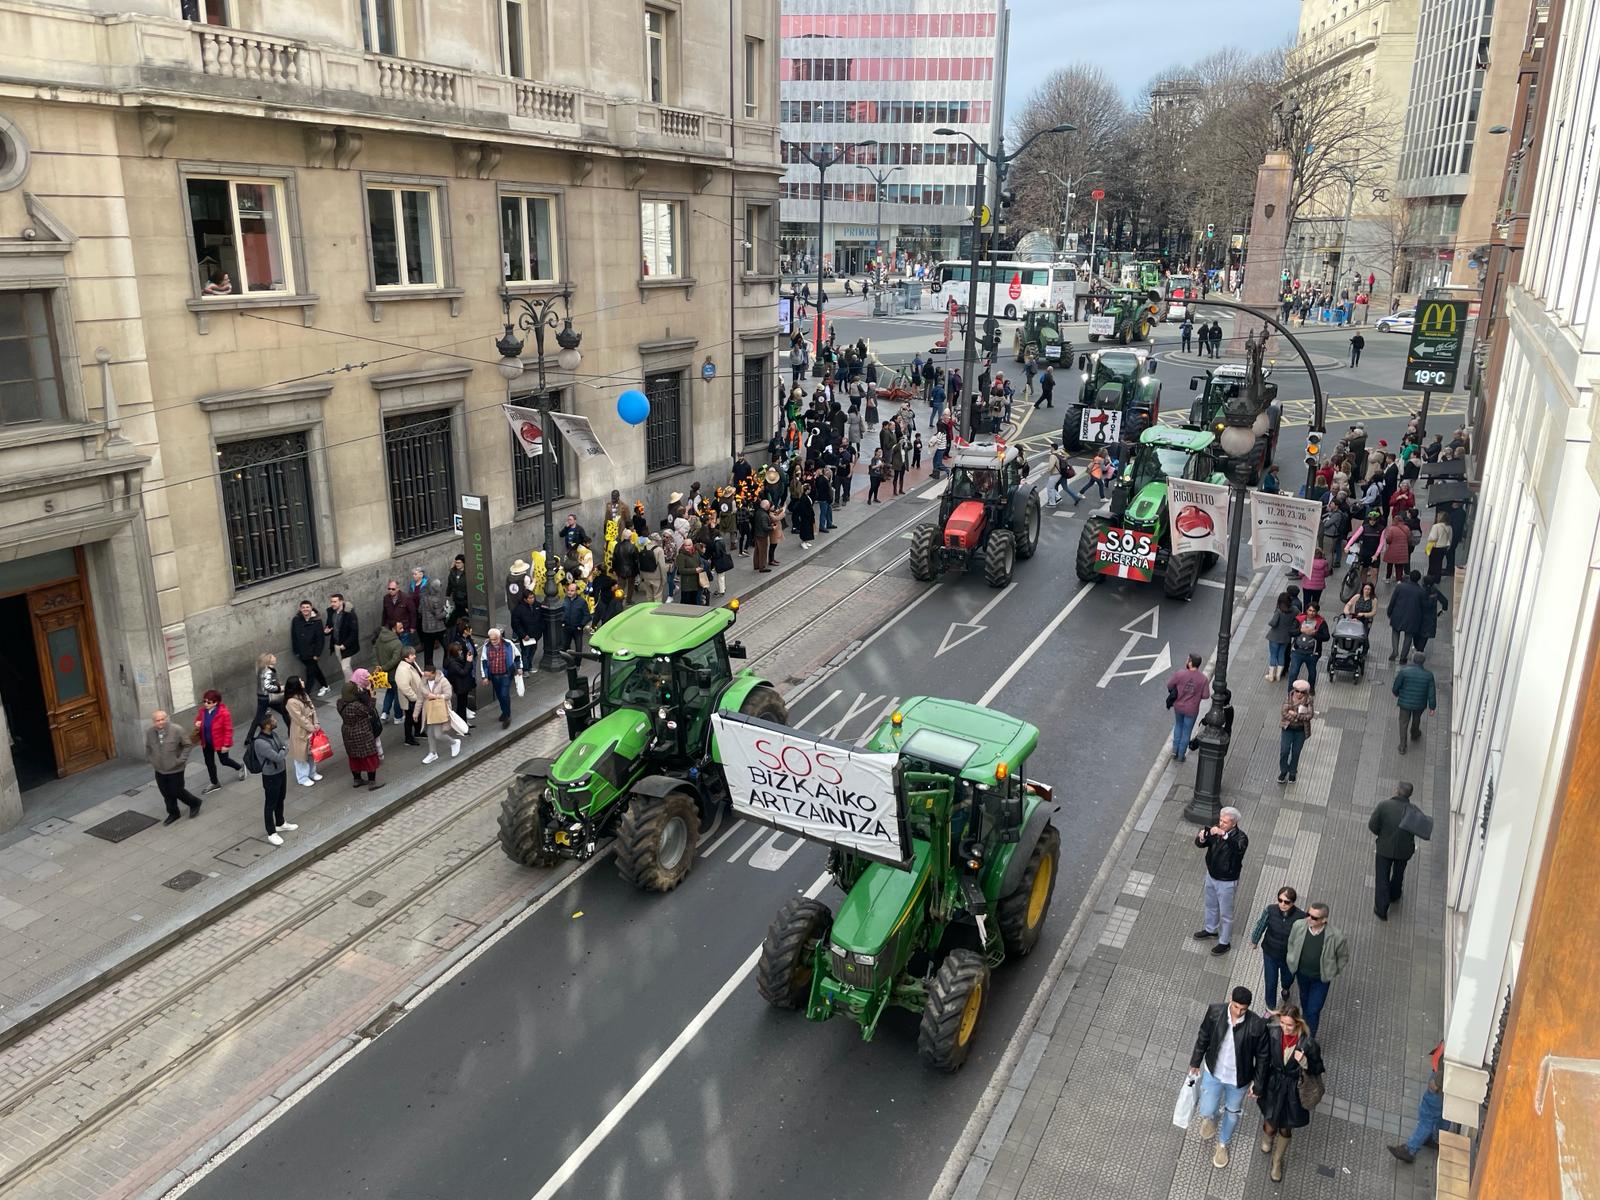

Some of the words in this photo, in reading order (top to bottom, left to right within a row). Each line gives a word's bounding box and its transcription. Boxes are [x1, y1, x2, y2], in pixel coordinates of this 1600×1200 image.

[843, 226, 880, 237] PRIMAR
[1414, 369, 1446, 385] 19°C
[1173, 490, 1215, 506] RIGOLETTO
[473, 532, 485, 593] Abando
[1100, 550, 1149, 570] BASERRIA
[755, 739, 843, 785] SOS
